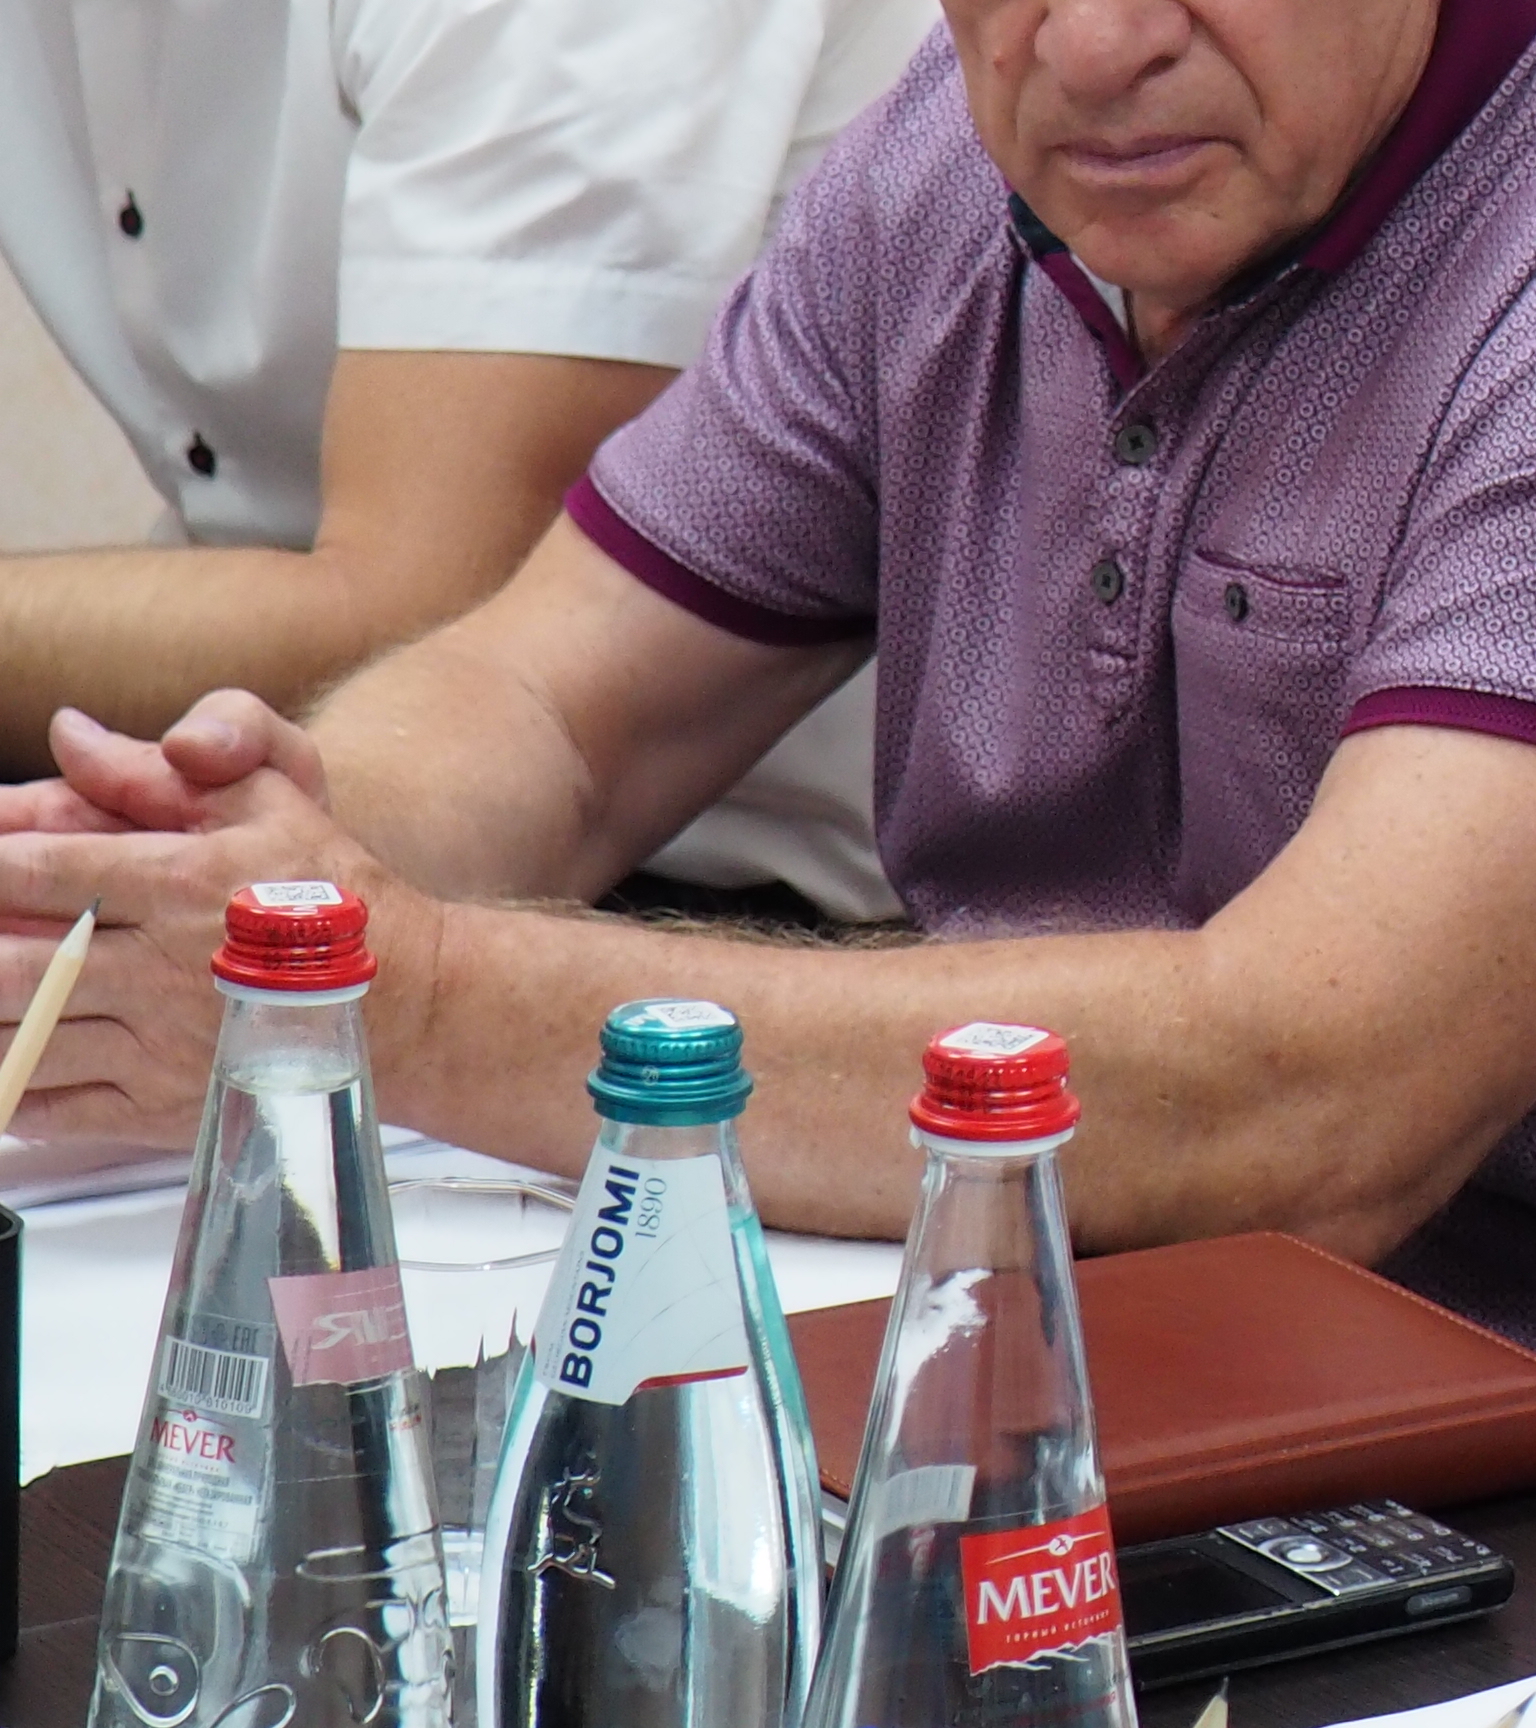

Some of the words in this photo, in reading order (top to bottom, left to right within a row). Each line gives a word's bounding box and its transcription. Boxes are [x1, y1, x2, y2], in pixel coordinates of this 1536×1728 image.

[635, 1177, 667, 1239] 1890
[559, 1164, 640, 1389] BORJOMI
[151, 1417, 235, 1463] MEVER
[977, 1552, 1116, 1624] MEVER
